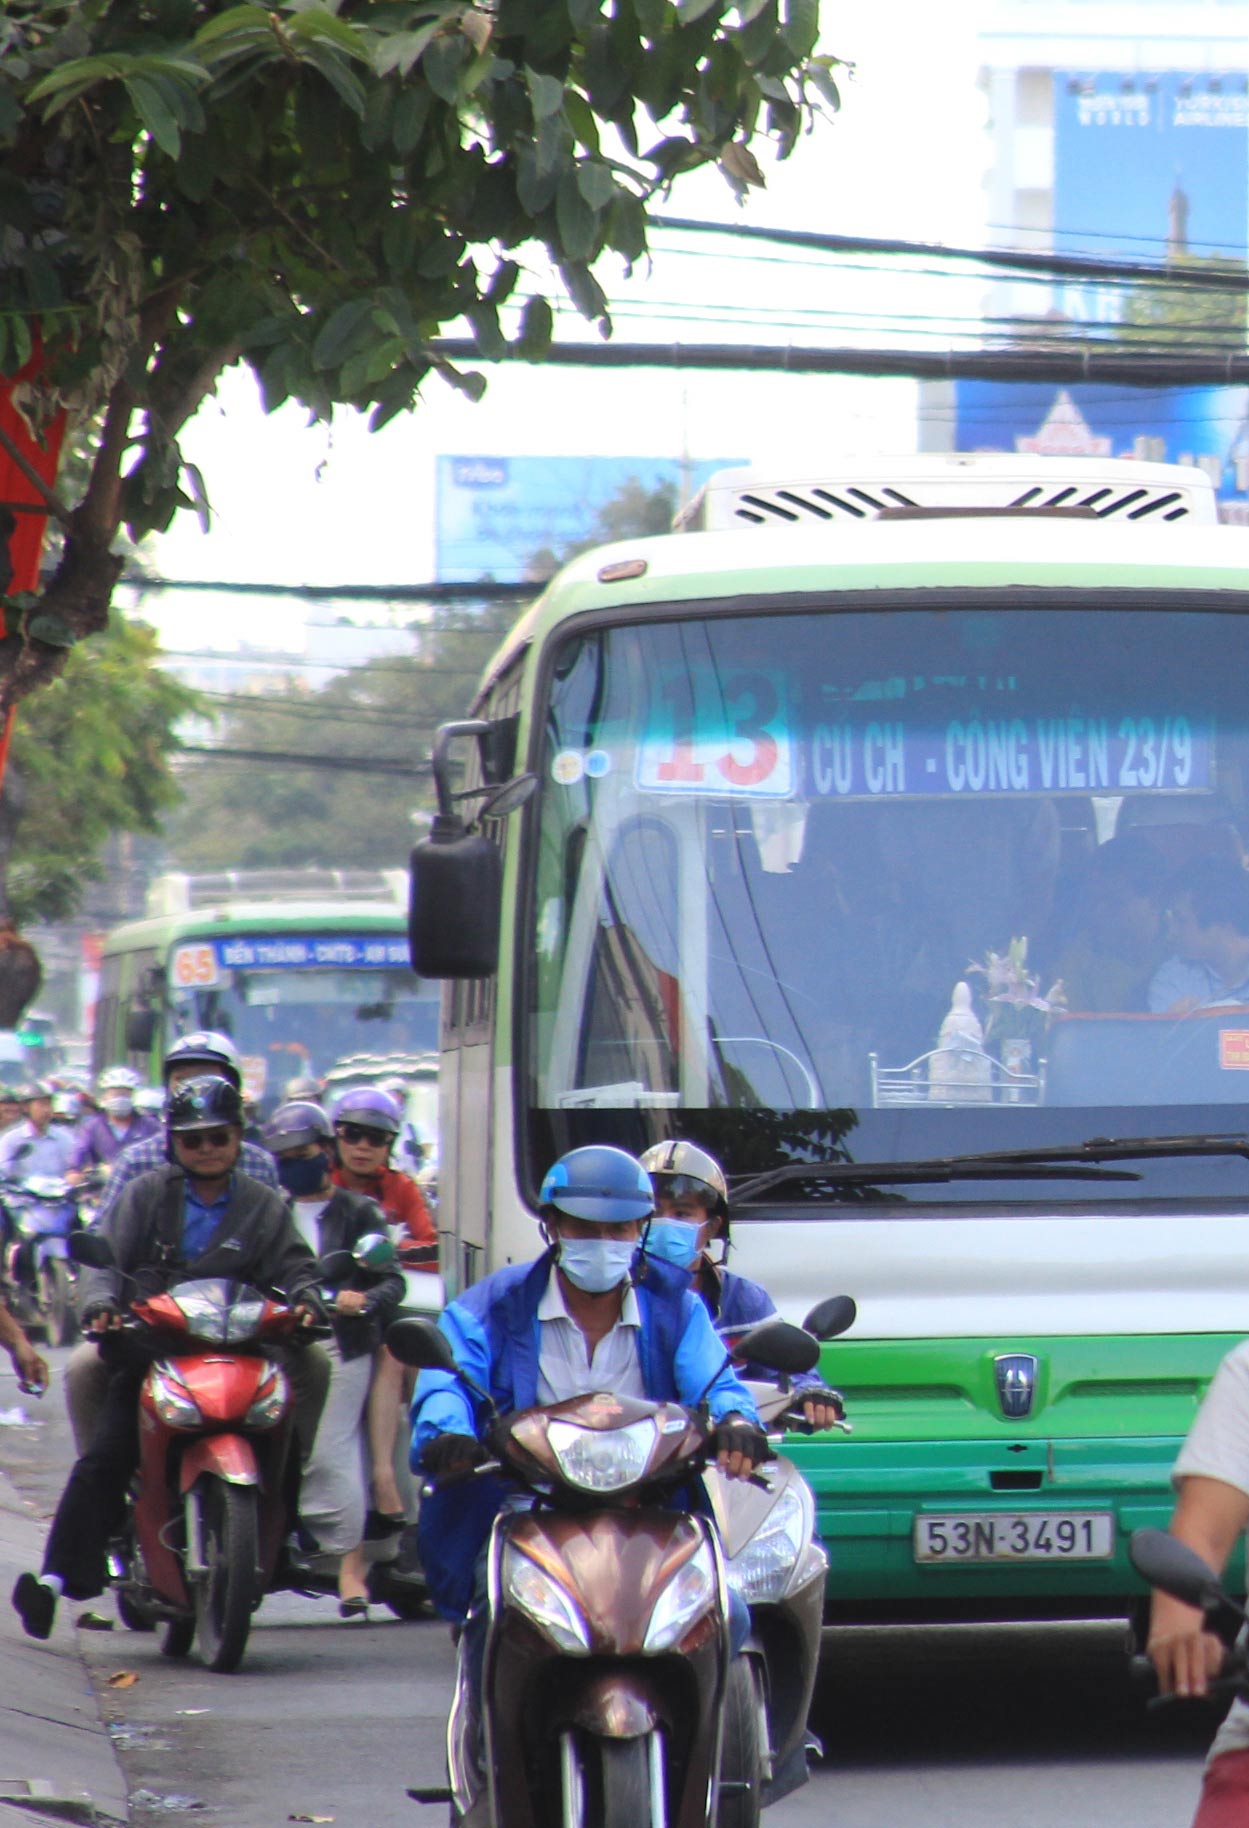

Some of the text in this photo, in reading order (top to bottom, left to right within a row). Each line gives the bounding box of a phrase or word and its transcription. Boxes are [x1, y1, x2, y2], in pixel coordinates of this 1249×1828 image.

[656, 671, 779, 786] 13
[1118, 714, 1193, 788] 23/9
[176, 948, 216, 985] 65
[927, 1519, 1094, 1555] 53N-3491
